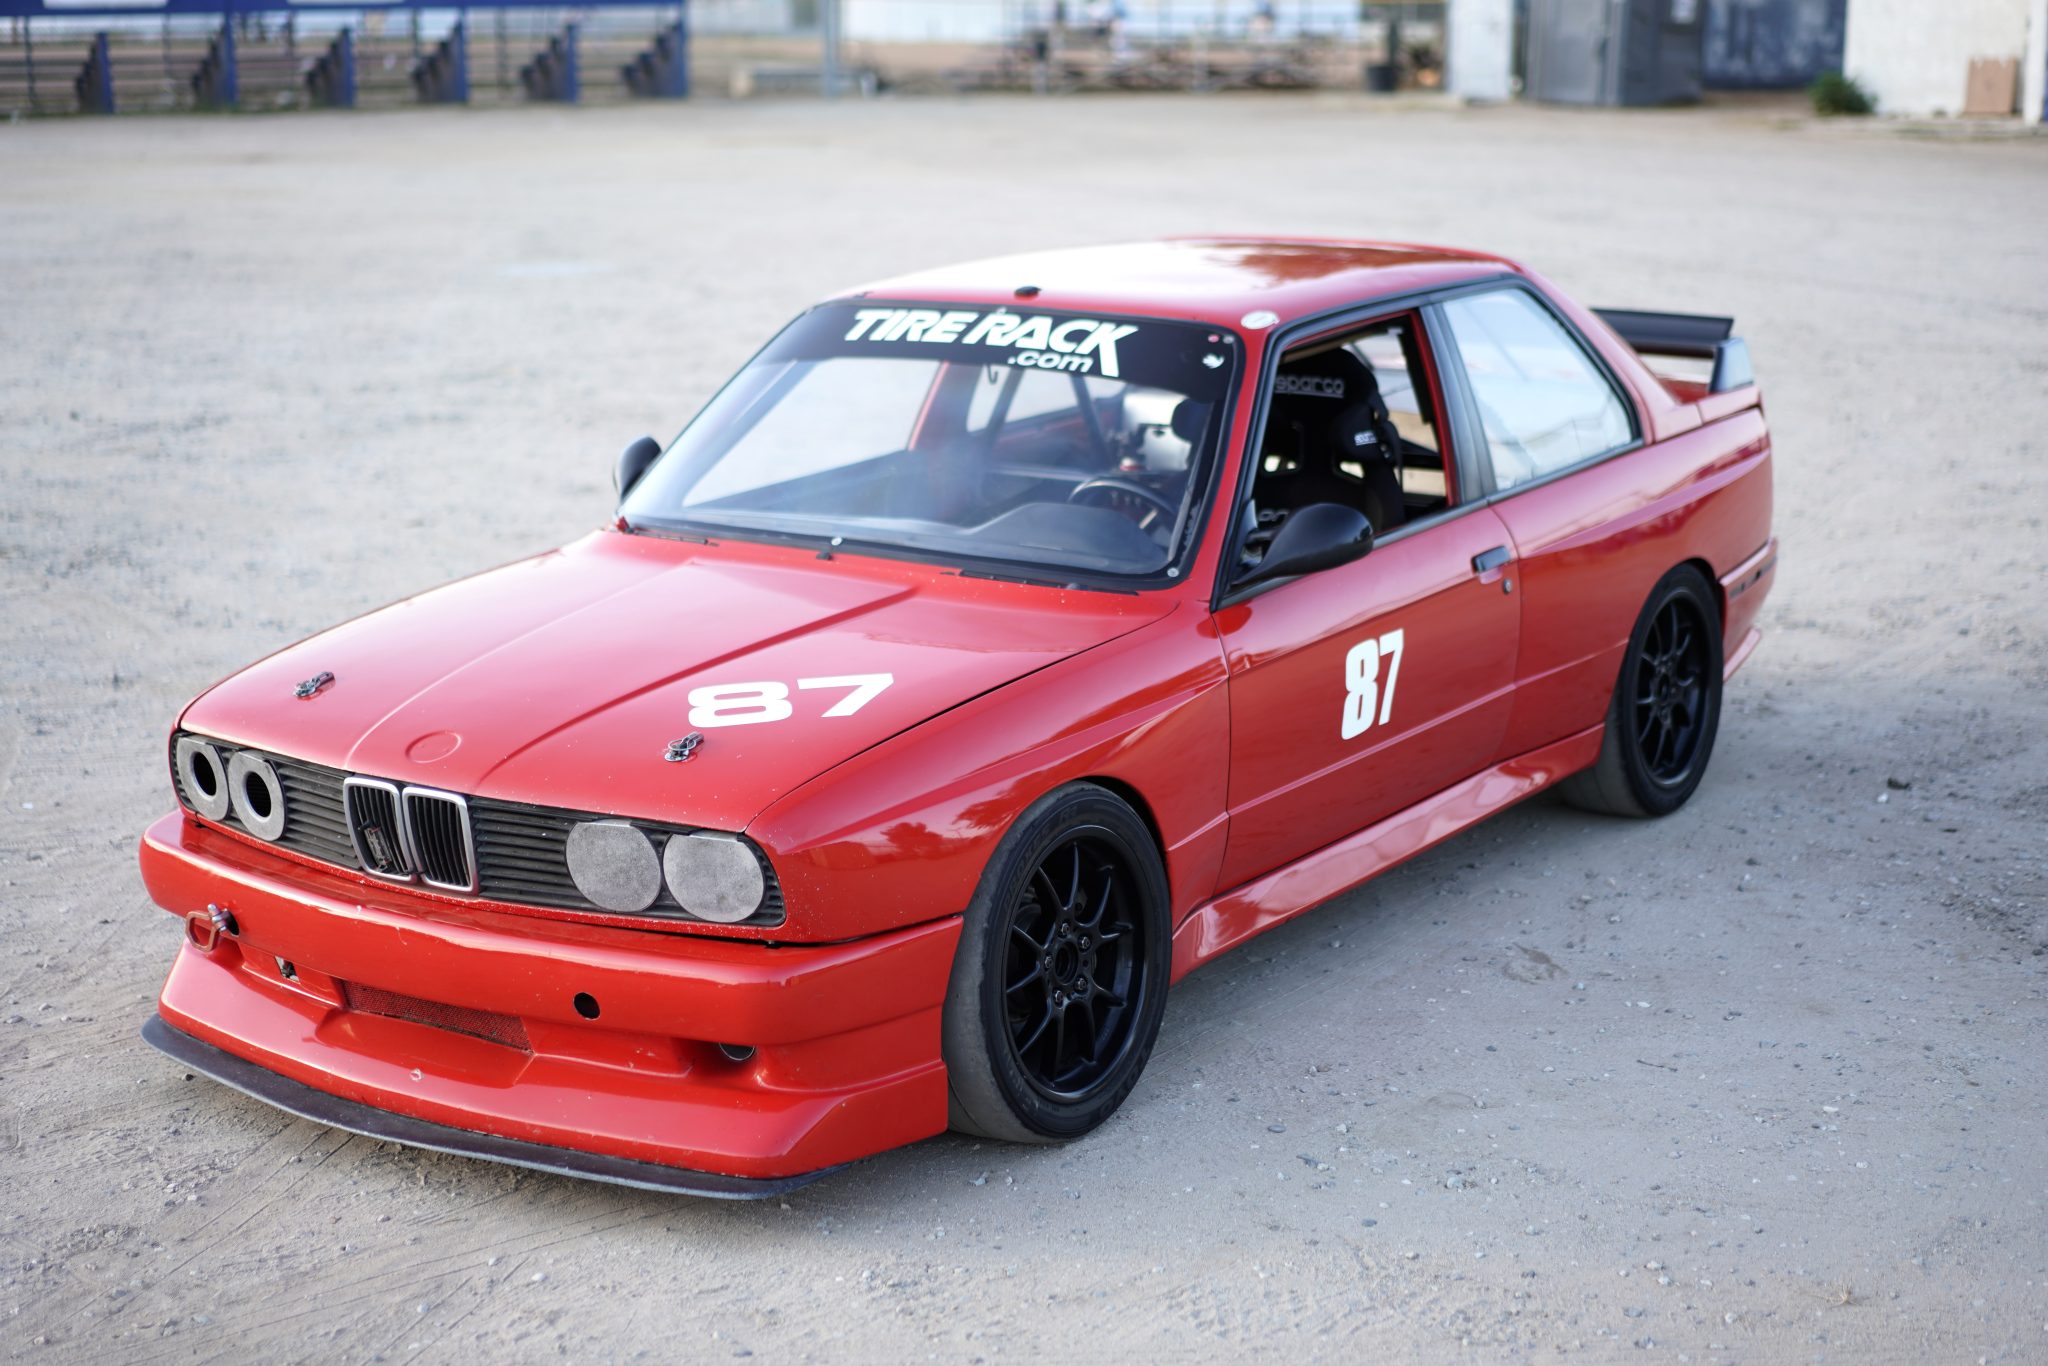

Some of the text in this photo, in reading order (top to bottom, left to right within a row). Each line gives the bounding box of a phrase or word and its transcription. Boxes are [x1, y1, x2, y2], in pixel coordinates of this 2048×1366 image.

[1007, 350, 1093, 373] .com
[688, 667, 894, 727] 87
[1341, 628, 1404, 740] 87
